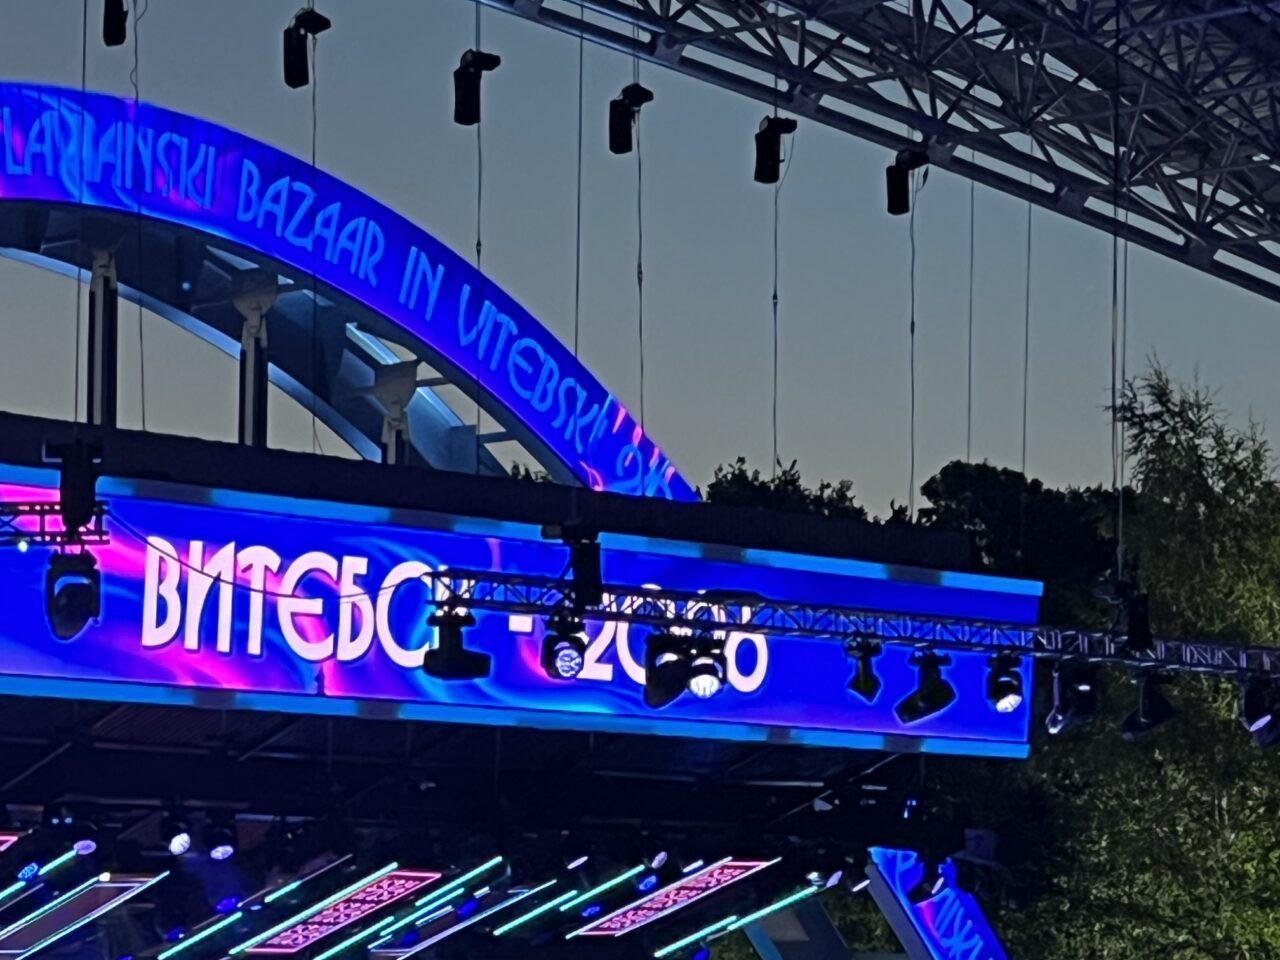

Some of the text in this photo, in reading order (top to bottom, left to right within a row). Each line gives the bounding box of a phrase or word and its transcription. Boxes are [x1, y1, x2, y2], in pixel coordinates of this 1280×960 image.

[236, 158, 385, 288] BAZAAR
[398, 246, 445, 321] IN
[575, 584, 768, 692] 206
